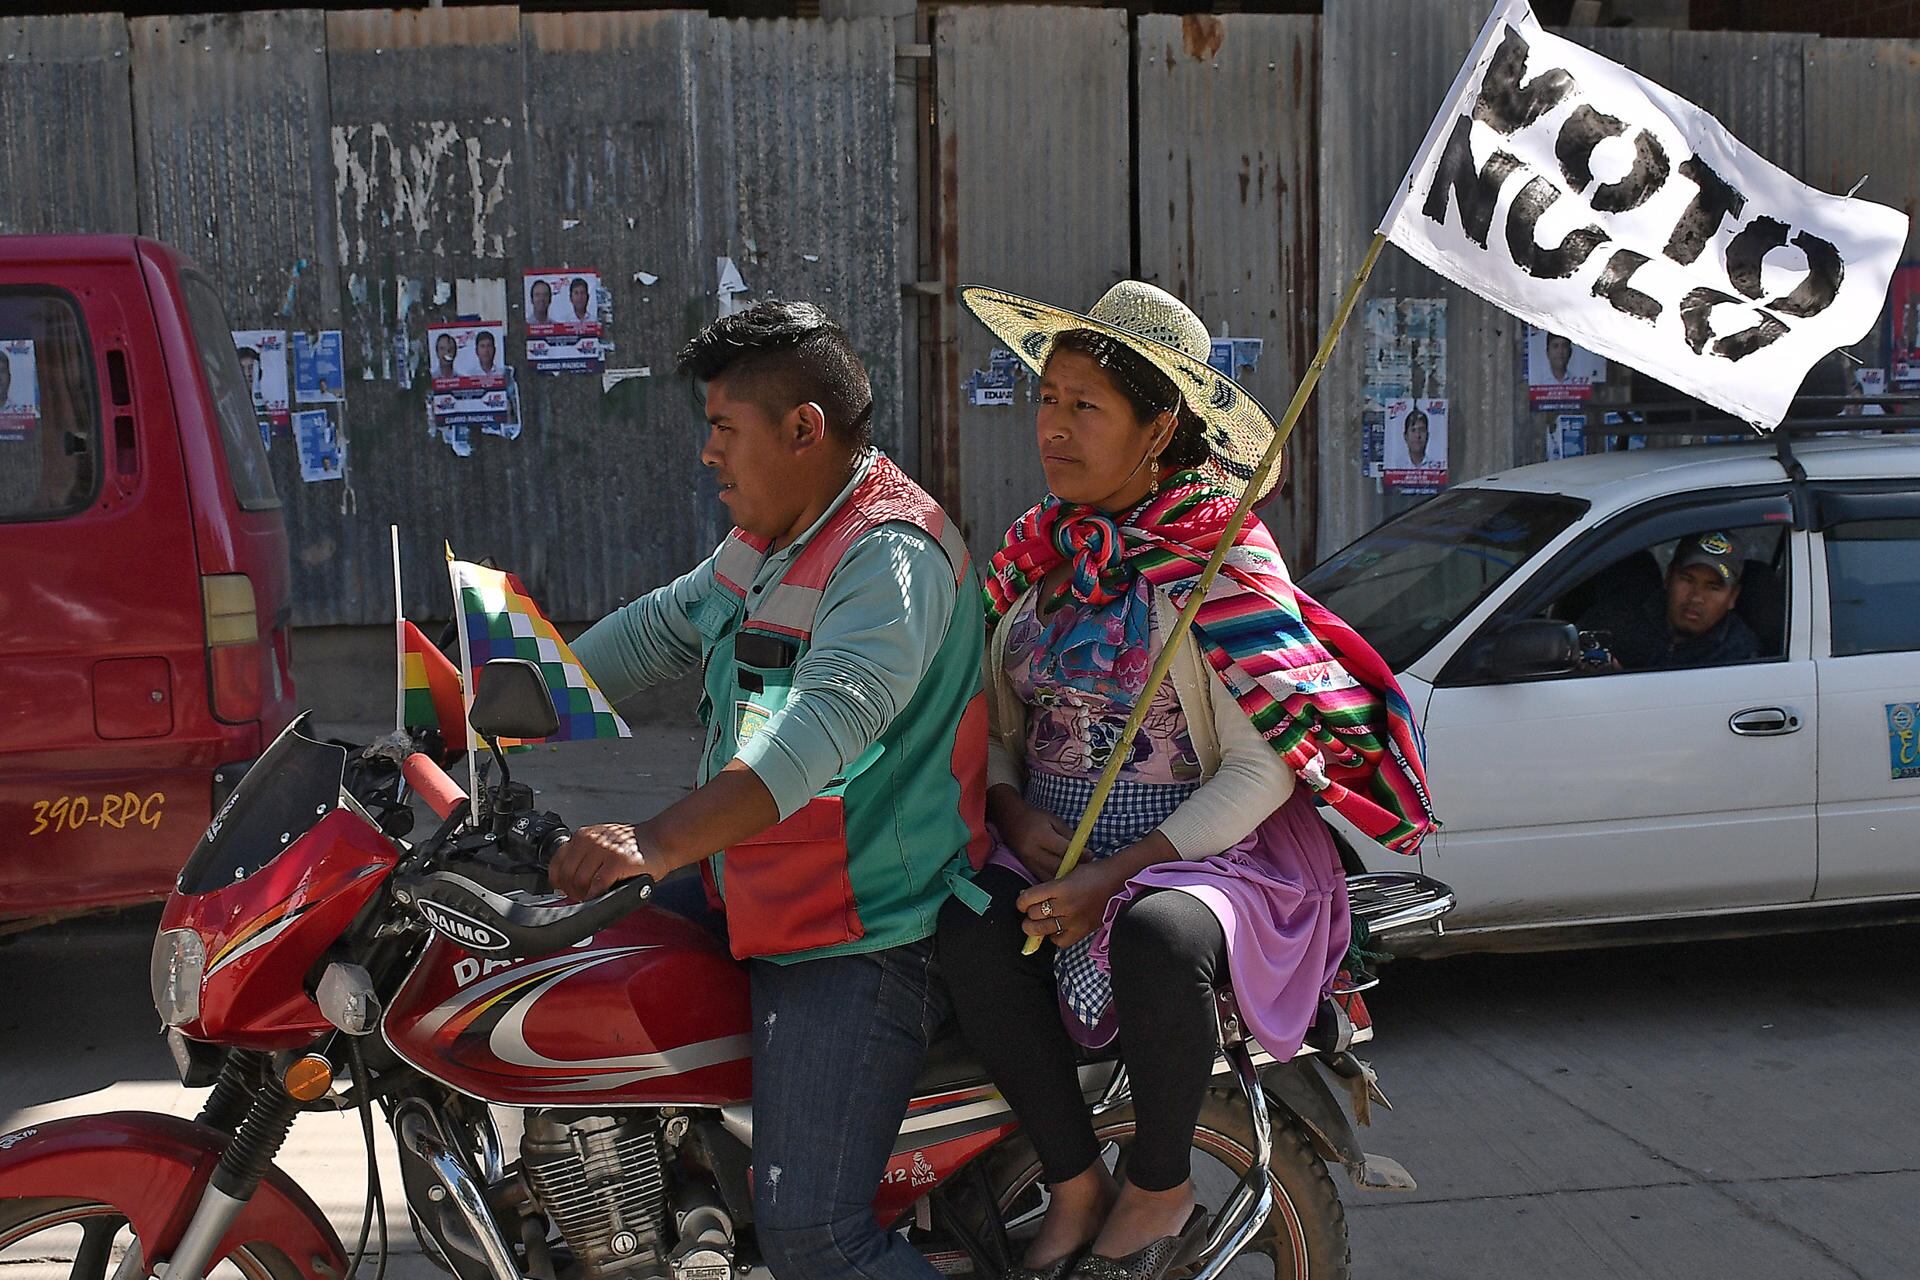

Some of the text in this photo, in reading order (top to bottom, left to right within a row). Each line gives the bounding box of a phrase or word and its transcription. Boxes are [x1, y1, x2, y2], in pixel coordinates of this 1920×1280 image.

[1472, 23, 1845, 319] VOTO
[1422, 113, 1791, 363] NULO
[29, 791, 165, 835] 390-RPG
[426, 905, 491, 945] DAIMO
[686, 1267, 727, 1278] ELECTRIC
